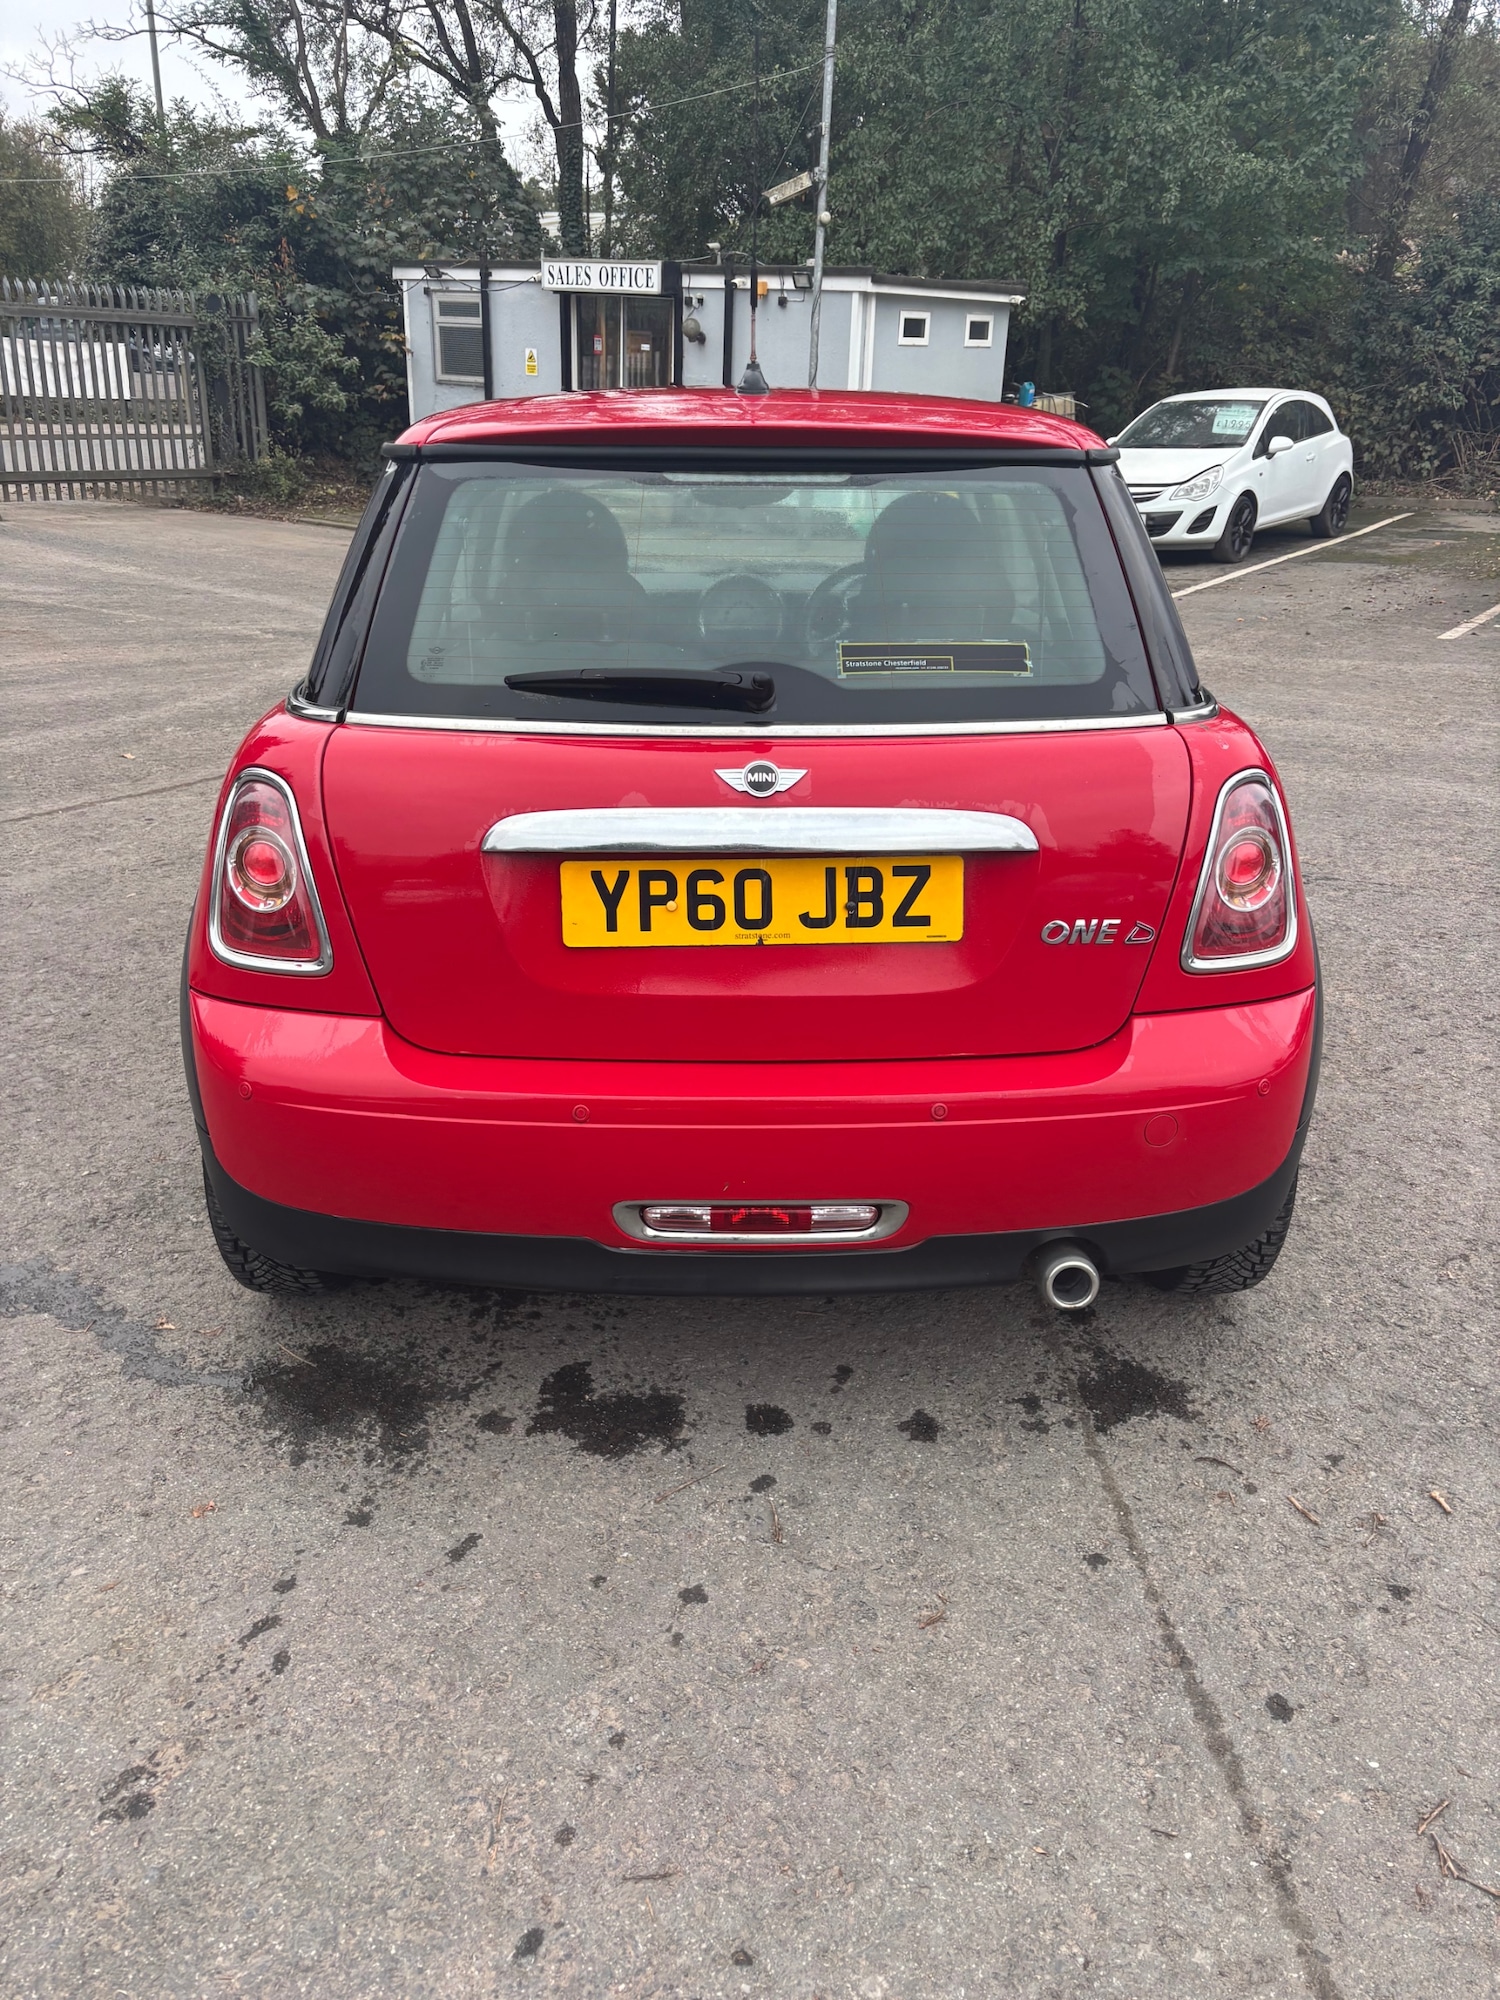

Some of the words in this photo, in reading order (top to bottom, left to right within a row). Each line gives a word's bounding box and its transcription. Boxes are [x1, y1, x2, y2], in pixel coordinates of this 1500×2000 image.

[547, 264, 592, 287] SALES
[599, 265, 655, 289] OFFICE
[845, 660, 882, 668] Stratstone
[883, 659, 927, 667] Chesterfield
[747, 772, 776, 783] MINI
[590, 868, 773, 932] YP60
[798, 865, 931, 929] JBZ
[734, 932, 791, 940] stratstone.com
[1041, 919, 1121, 944] ONE
[1124, 920, 1156, 944] D
